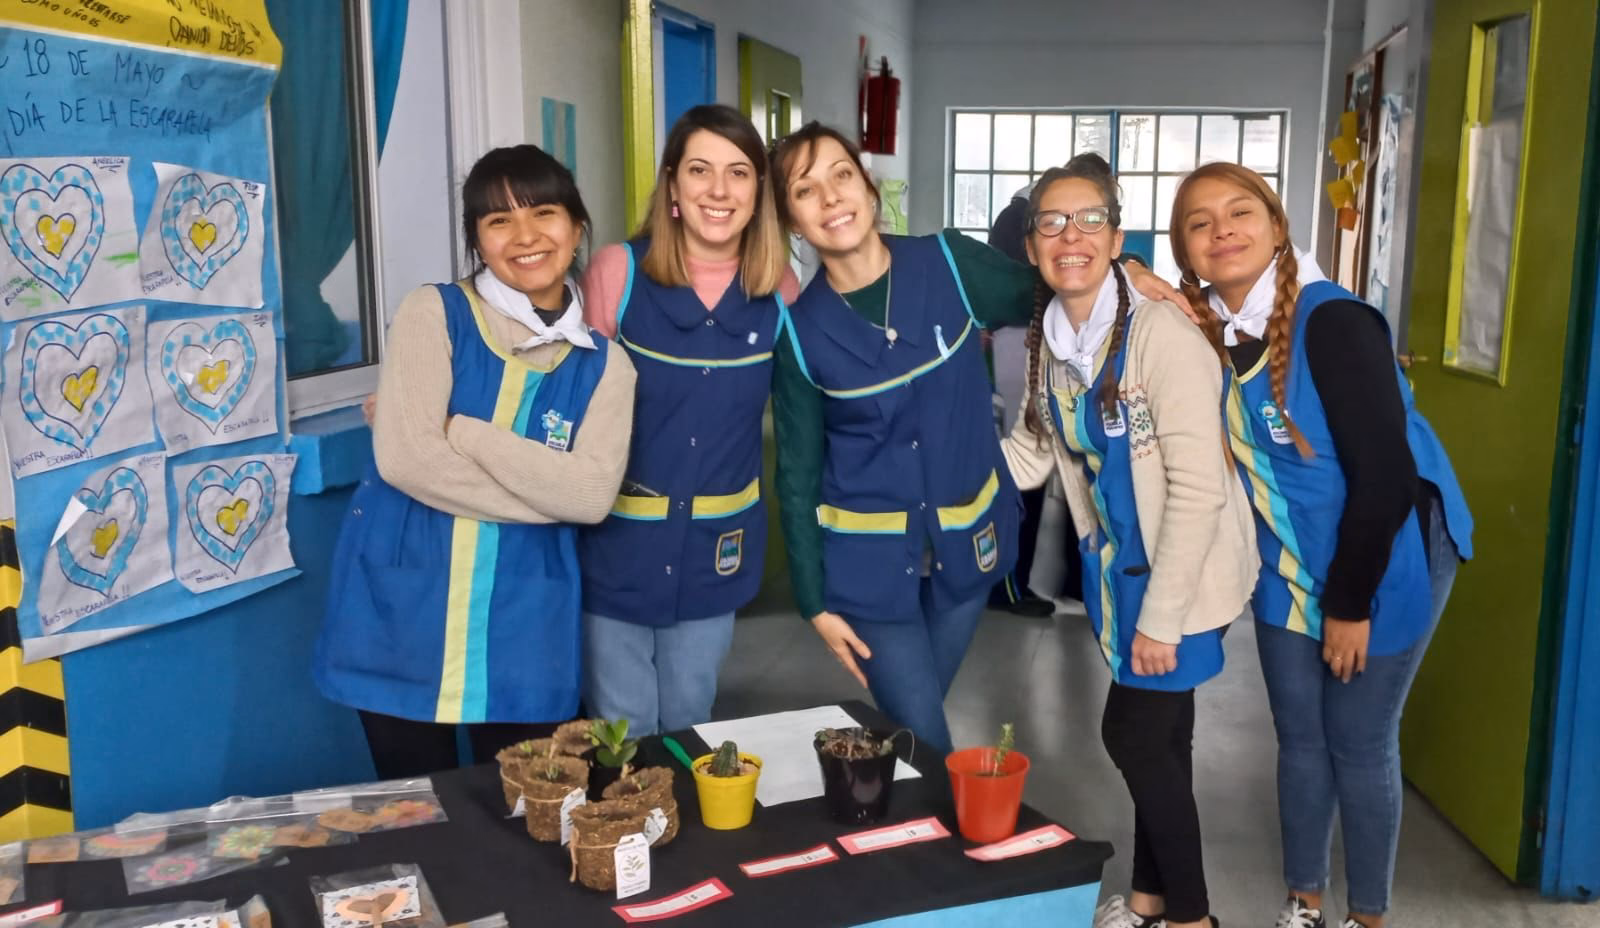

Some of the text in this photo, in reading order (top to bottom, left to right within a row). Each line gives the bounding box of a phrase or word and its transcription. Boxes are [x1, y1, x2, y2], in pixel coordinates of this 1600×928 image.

[24, 37, 166, 97] 18 DE MAYO
[60, 98, 87, 124] DE
[99, 101, 119, 129] LA
